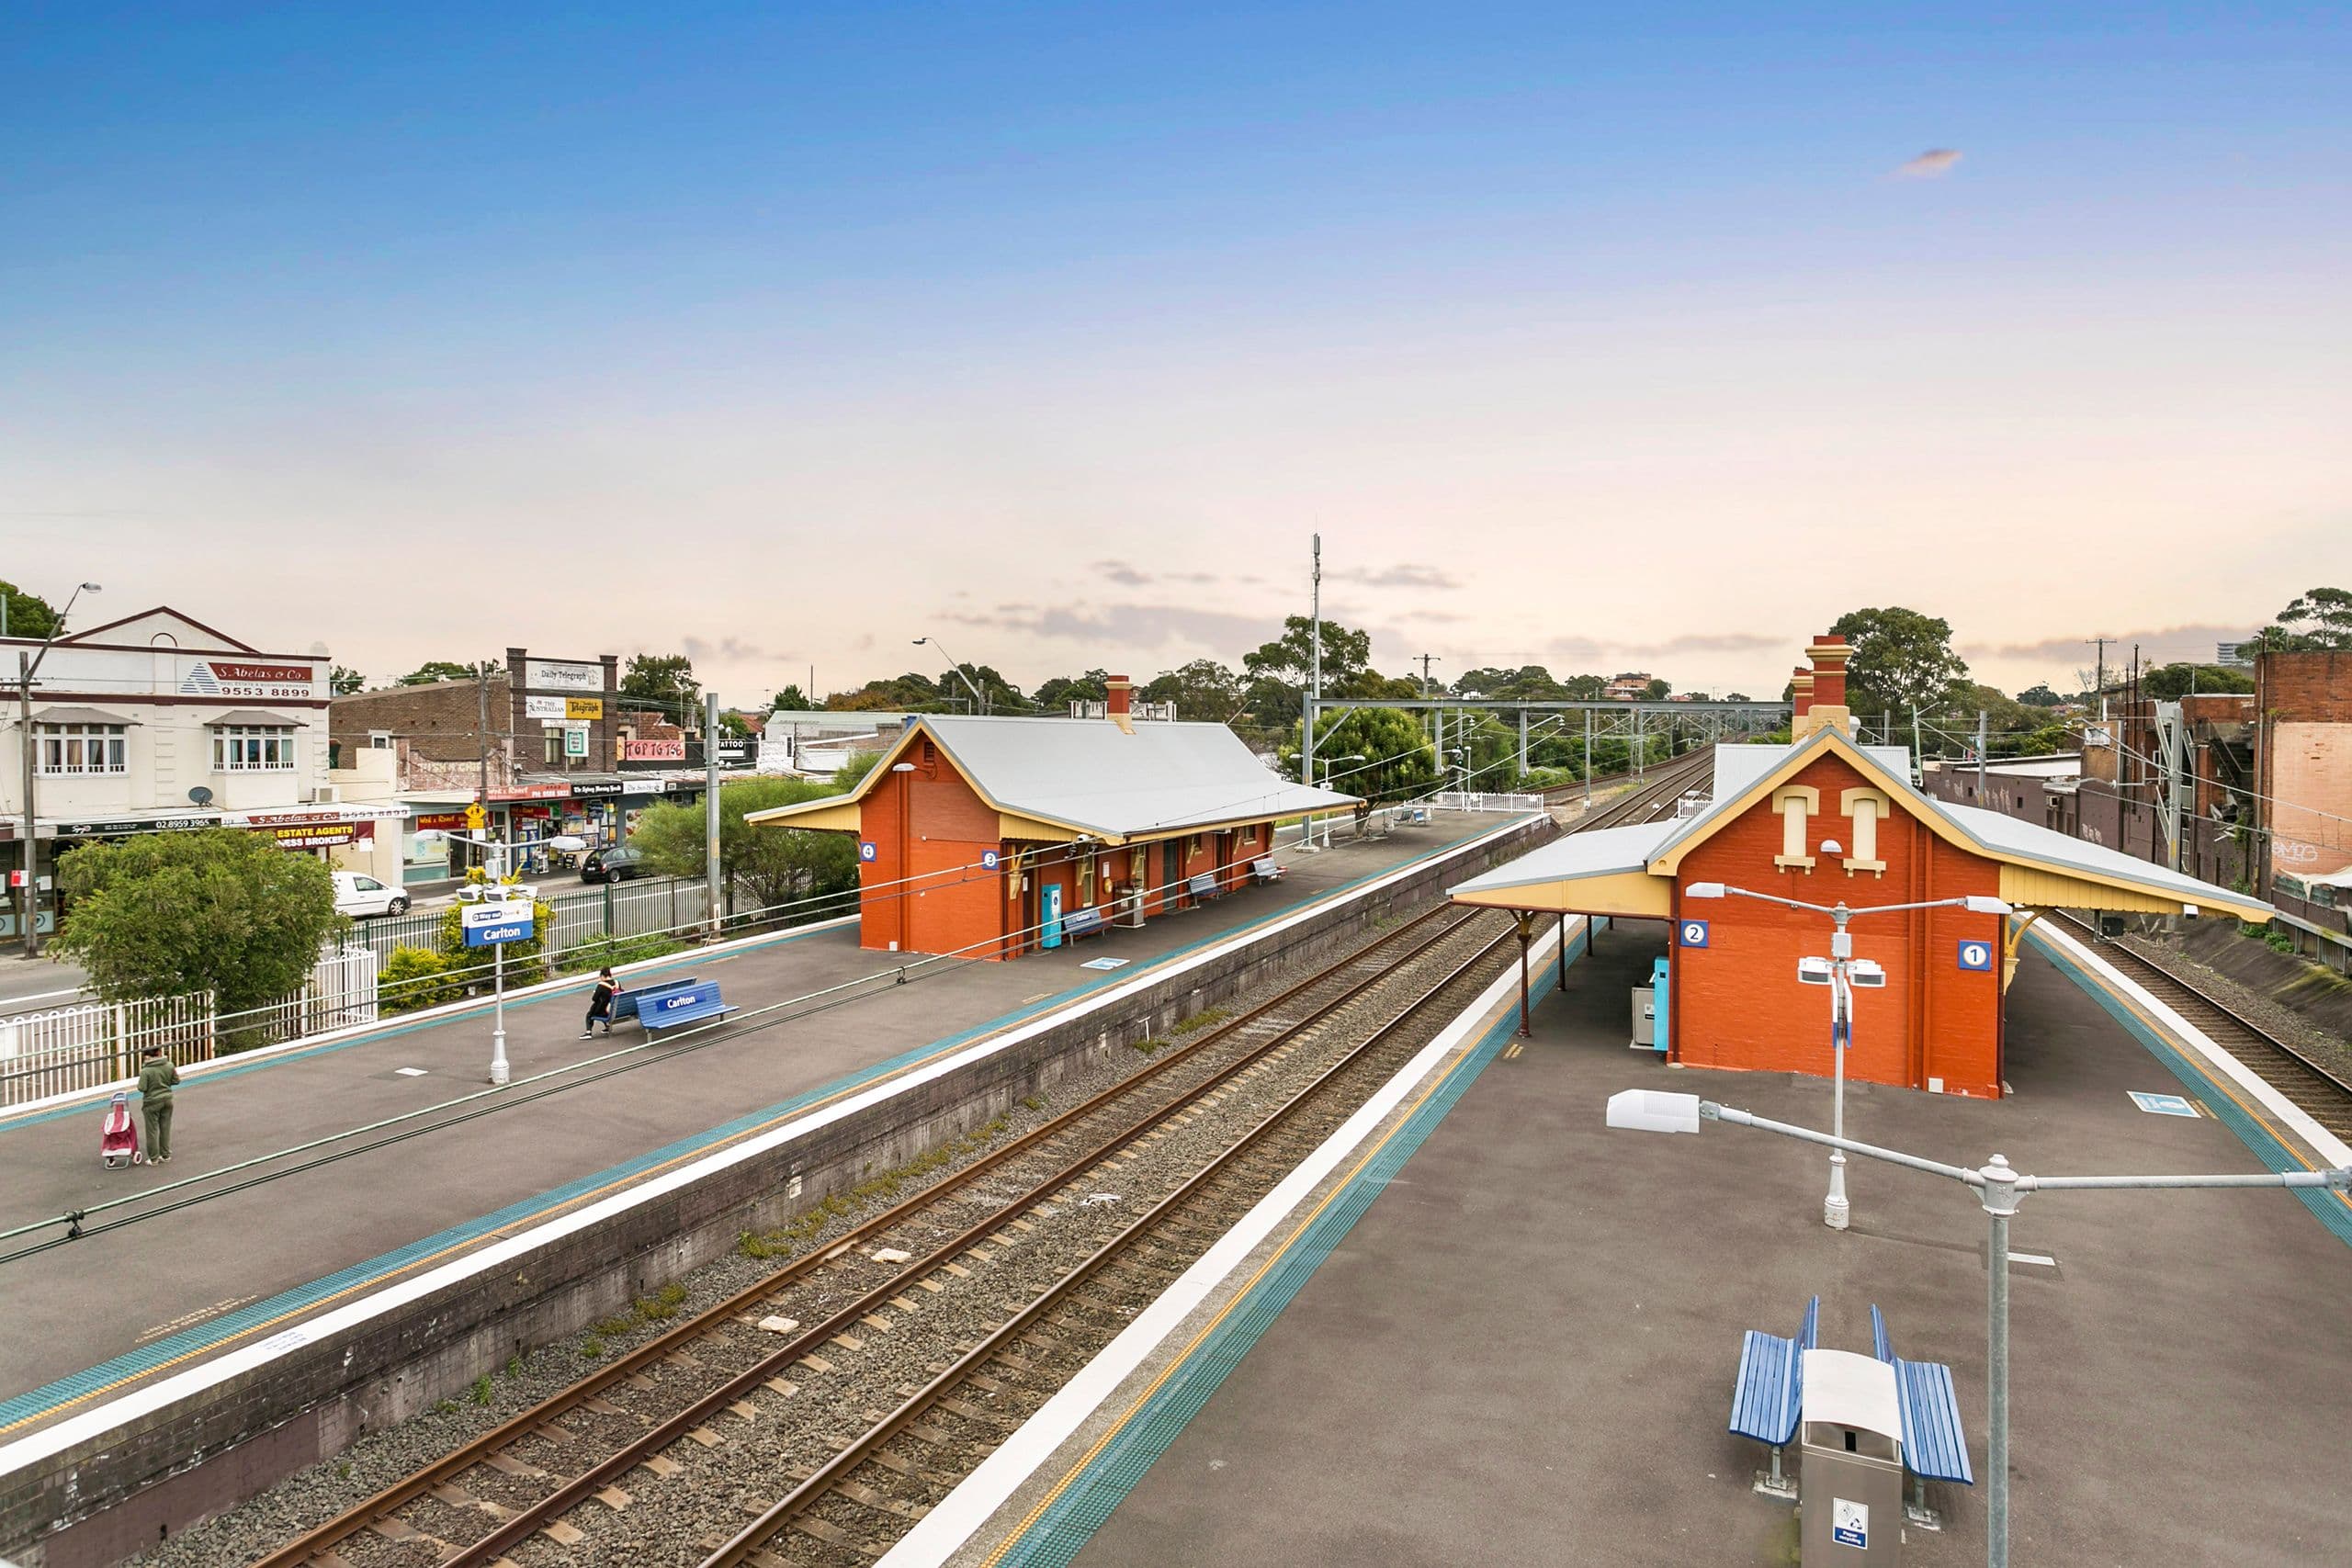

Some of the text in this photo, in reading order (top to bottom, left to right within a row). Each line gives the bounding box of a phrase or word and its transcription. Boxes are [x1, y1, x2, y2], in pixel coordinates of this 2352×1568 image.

[287, 669, 305, 680] Co.
[541, 670, 557, 680] Daily
[558, 671, 587, 682] Telegraph
[221, 686, 310, 697] 9553 8899
[156, 820, 166, 829] 02
[277, 826, 354, 838] ESTATE AGENTS
[483, 927, 521, 941] Carlton
[1690, 926, 1699, 940] 2
[1970, 948, 1977, 962] 1
[667, 995, 695, 1009] Carlton
